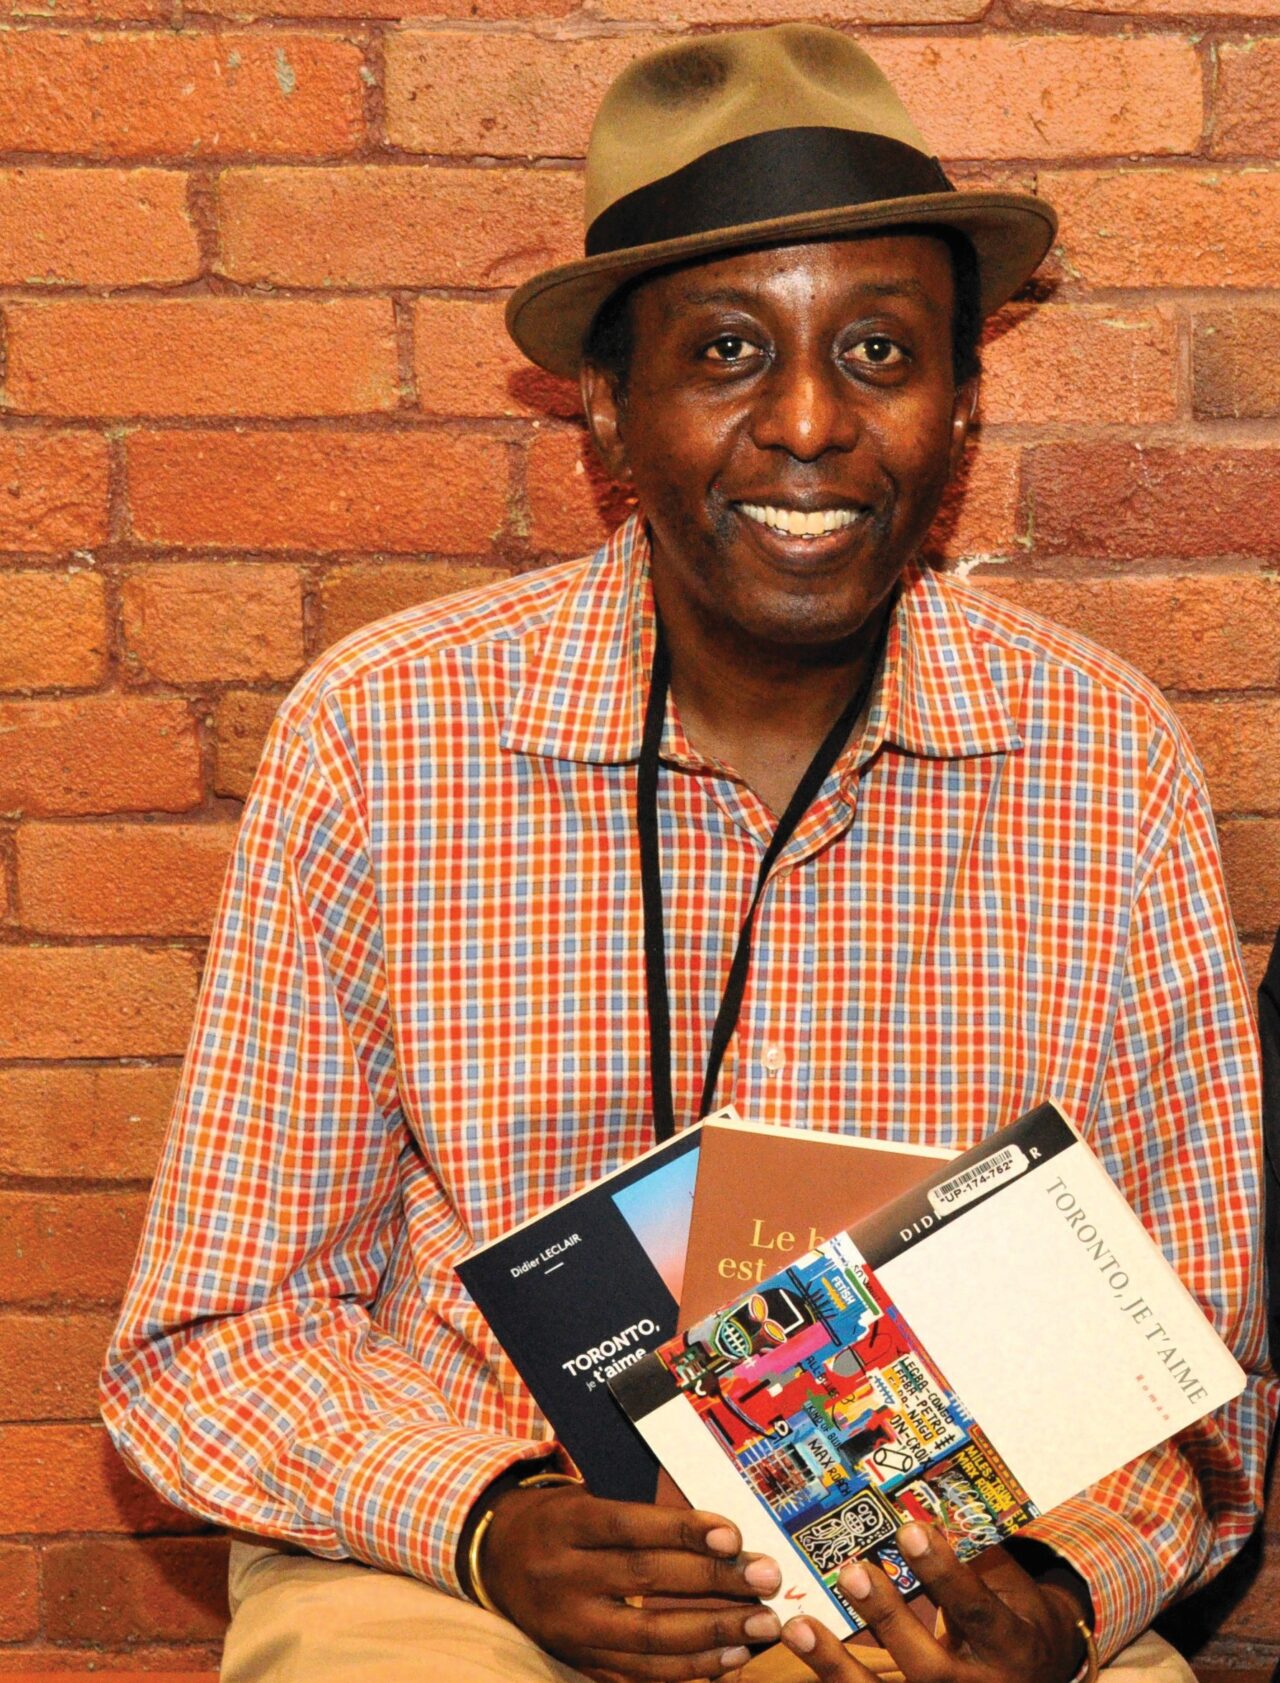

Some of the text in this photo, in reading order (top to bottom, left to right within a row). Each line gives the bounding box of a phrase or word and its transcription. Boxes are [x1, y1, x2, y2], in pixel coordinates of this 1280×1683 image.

[510, 1233, 582, 1279] Didier LECLAIR
[750, 1218, 795, 1252] Le
[718, 1258, 766, 1283] est
[1045, 1176, 1208, 1405] TORONTO, JE T'AIME
[562, 1319, 660, 1376] TORONTO,
[586, 1348, 646, 1392] je t'aime
[808, 1438, 835, 1468] MAX
